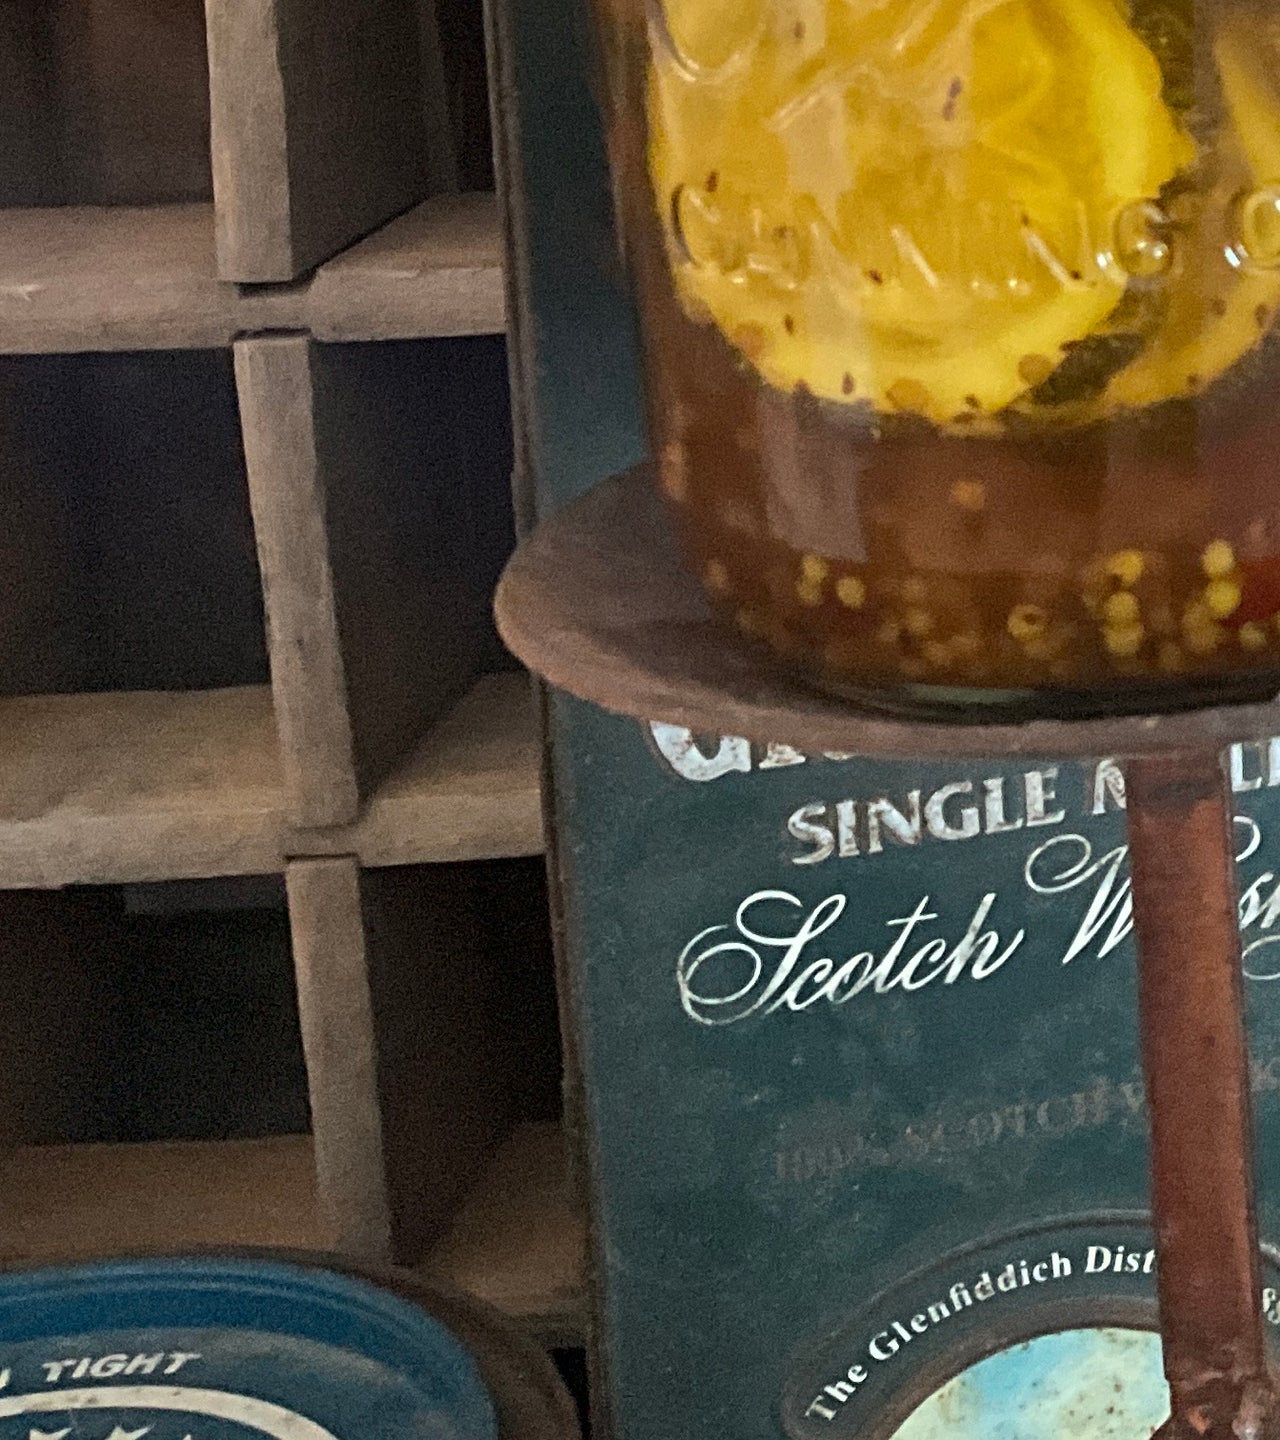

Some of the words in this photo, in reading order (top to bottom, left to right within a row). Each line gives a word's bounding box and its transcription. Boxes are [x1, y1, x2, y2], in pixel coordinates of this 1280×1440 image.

[786, 766, 1066, 866] SINGLE
[676, 888, 1026, 1026] Scotch
[42, 1352, 202, 1383] TIGHT
[804, 1362, 869, 1424] The
[868, 1251, 1073, 1363] Glenfiddich
